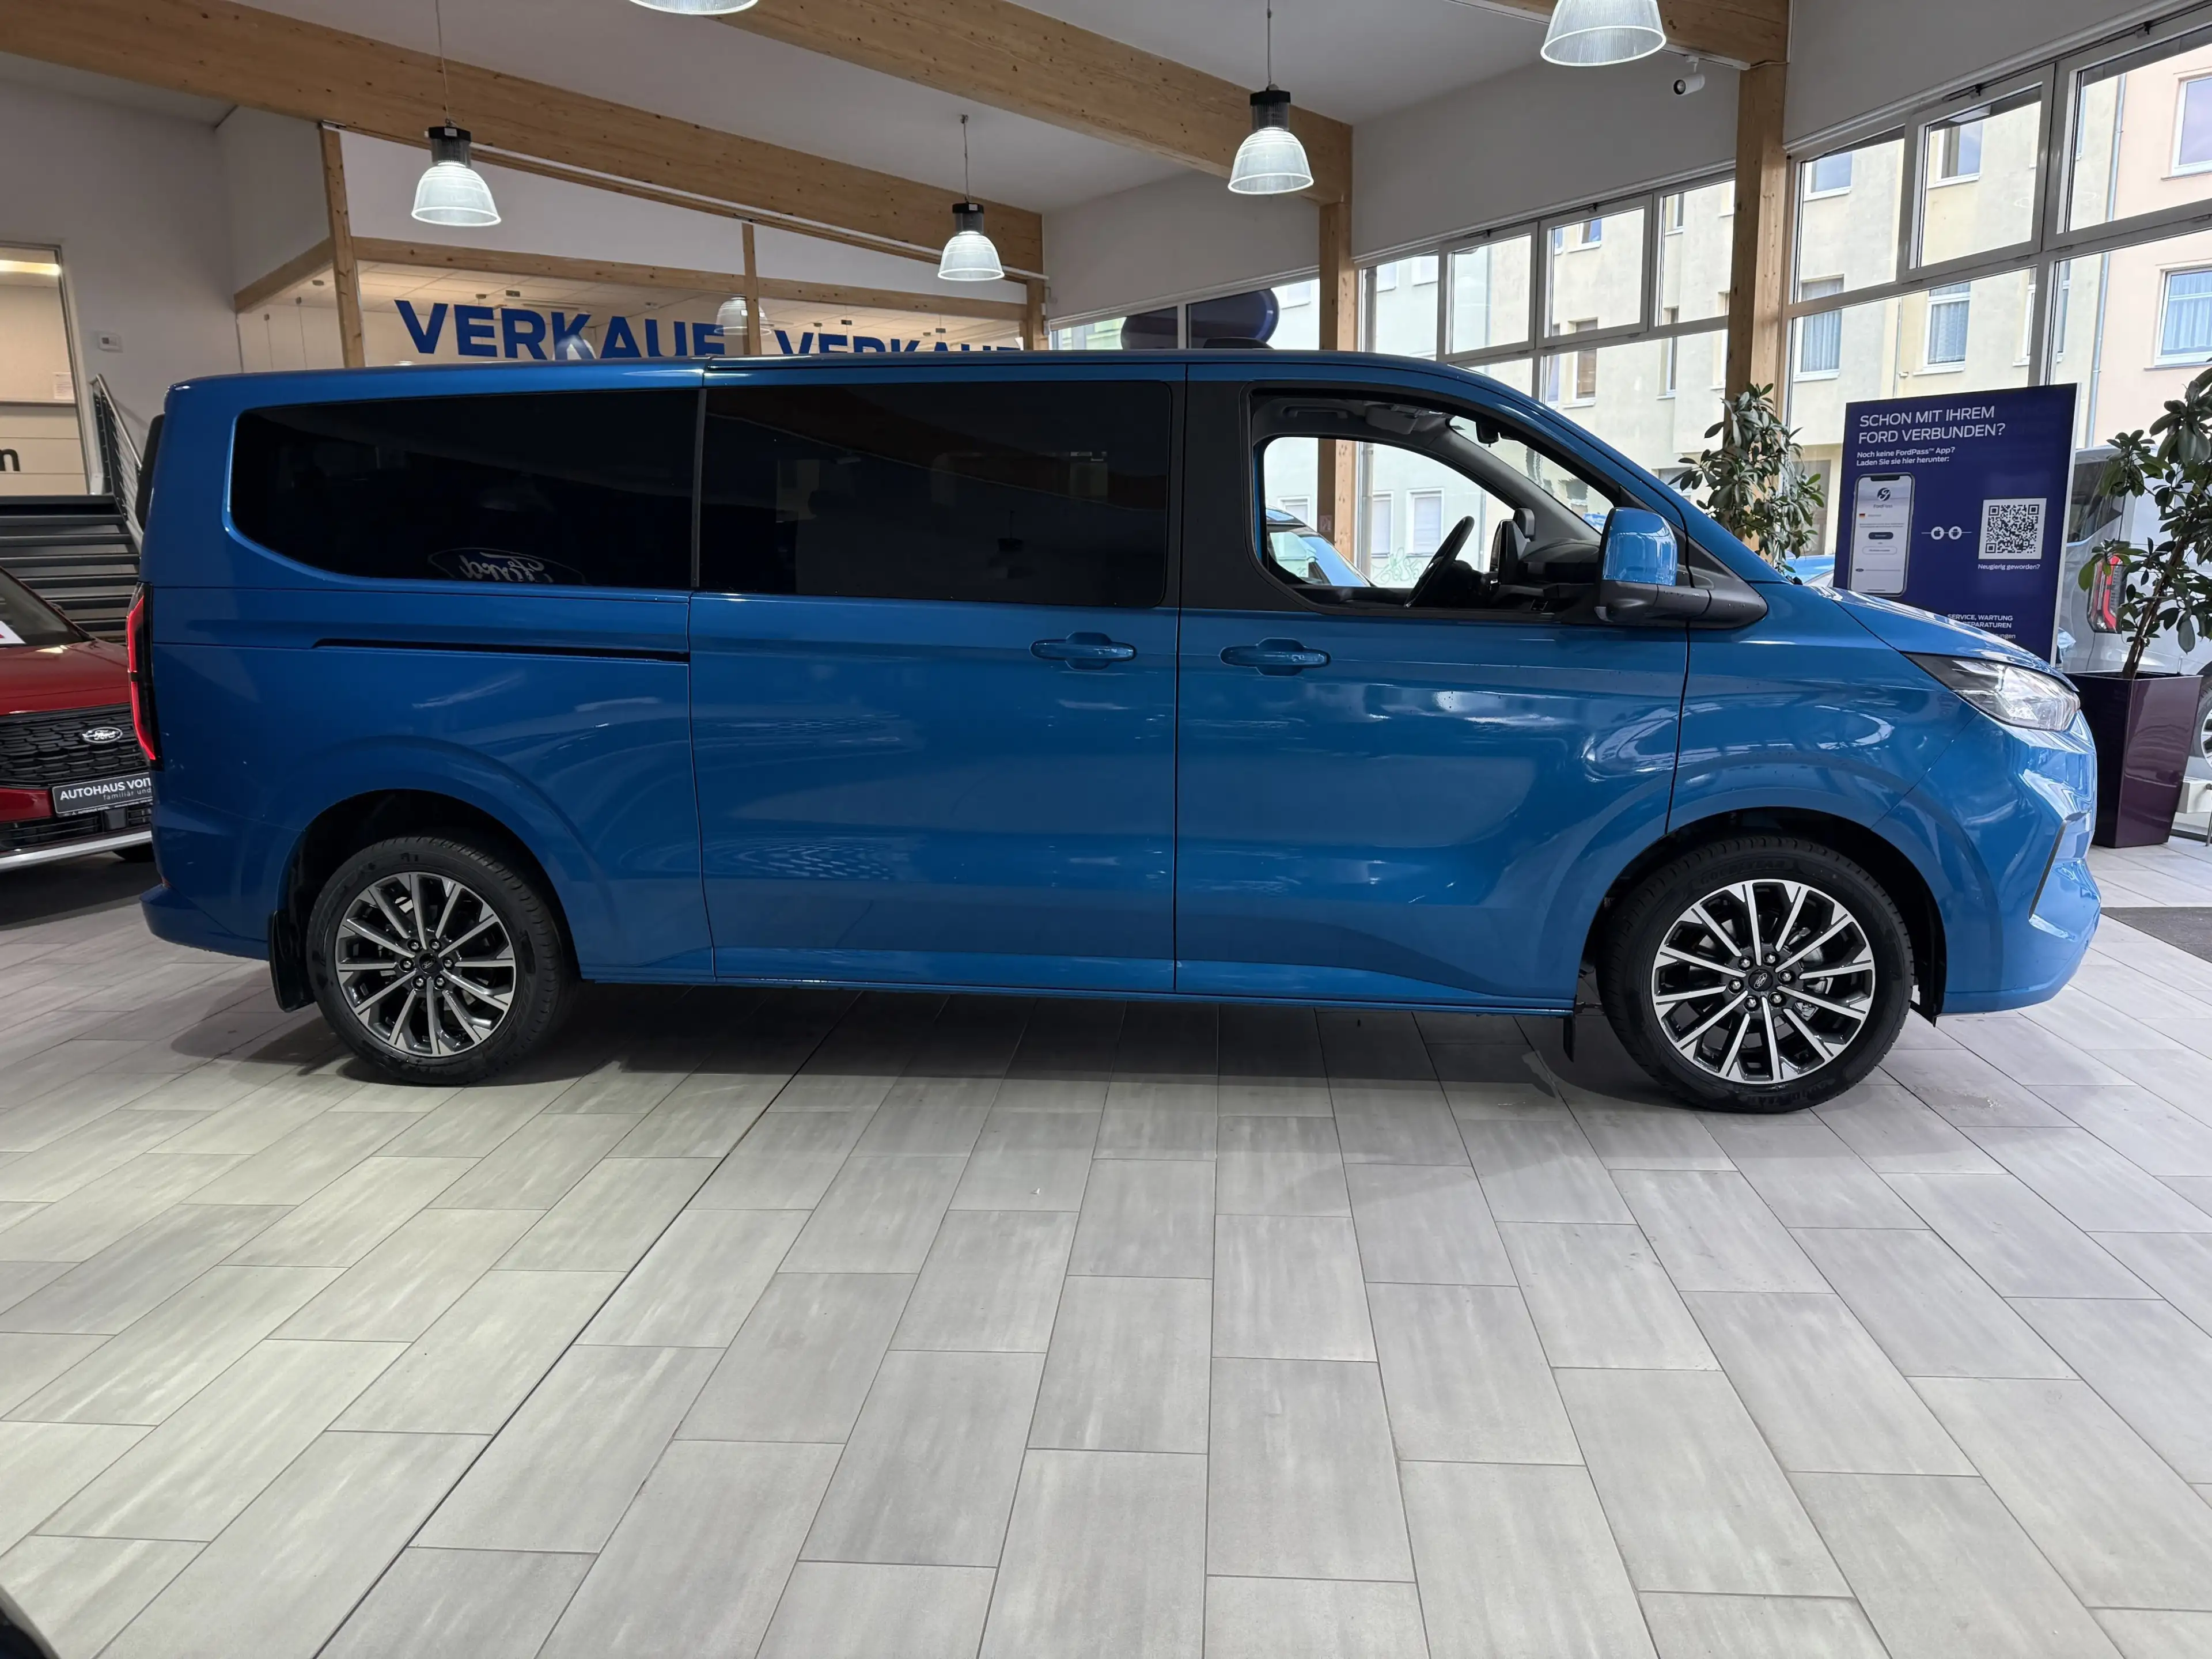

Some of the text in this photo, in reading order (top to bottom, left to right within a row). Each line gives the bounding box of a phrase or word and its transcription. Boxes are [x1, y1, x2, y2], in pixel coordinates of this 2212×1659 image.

[394, 299, 725, 360] VERKAUF
[1859, 406, 1995, 427] SCHON MIT IHREM
[1858, 423, 2006, 444] FORD VERBUNDEN?
[1936, 446, 1956, 454] App?
[60, 781, 126, 800] AUTOHAUS
[137, 787, 152, 796] und
